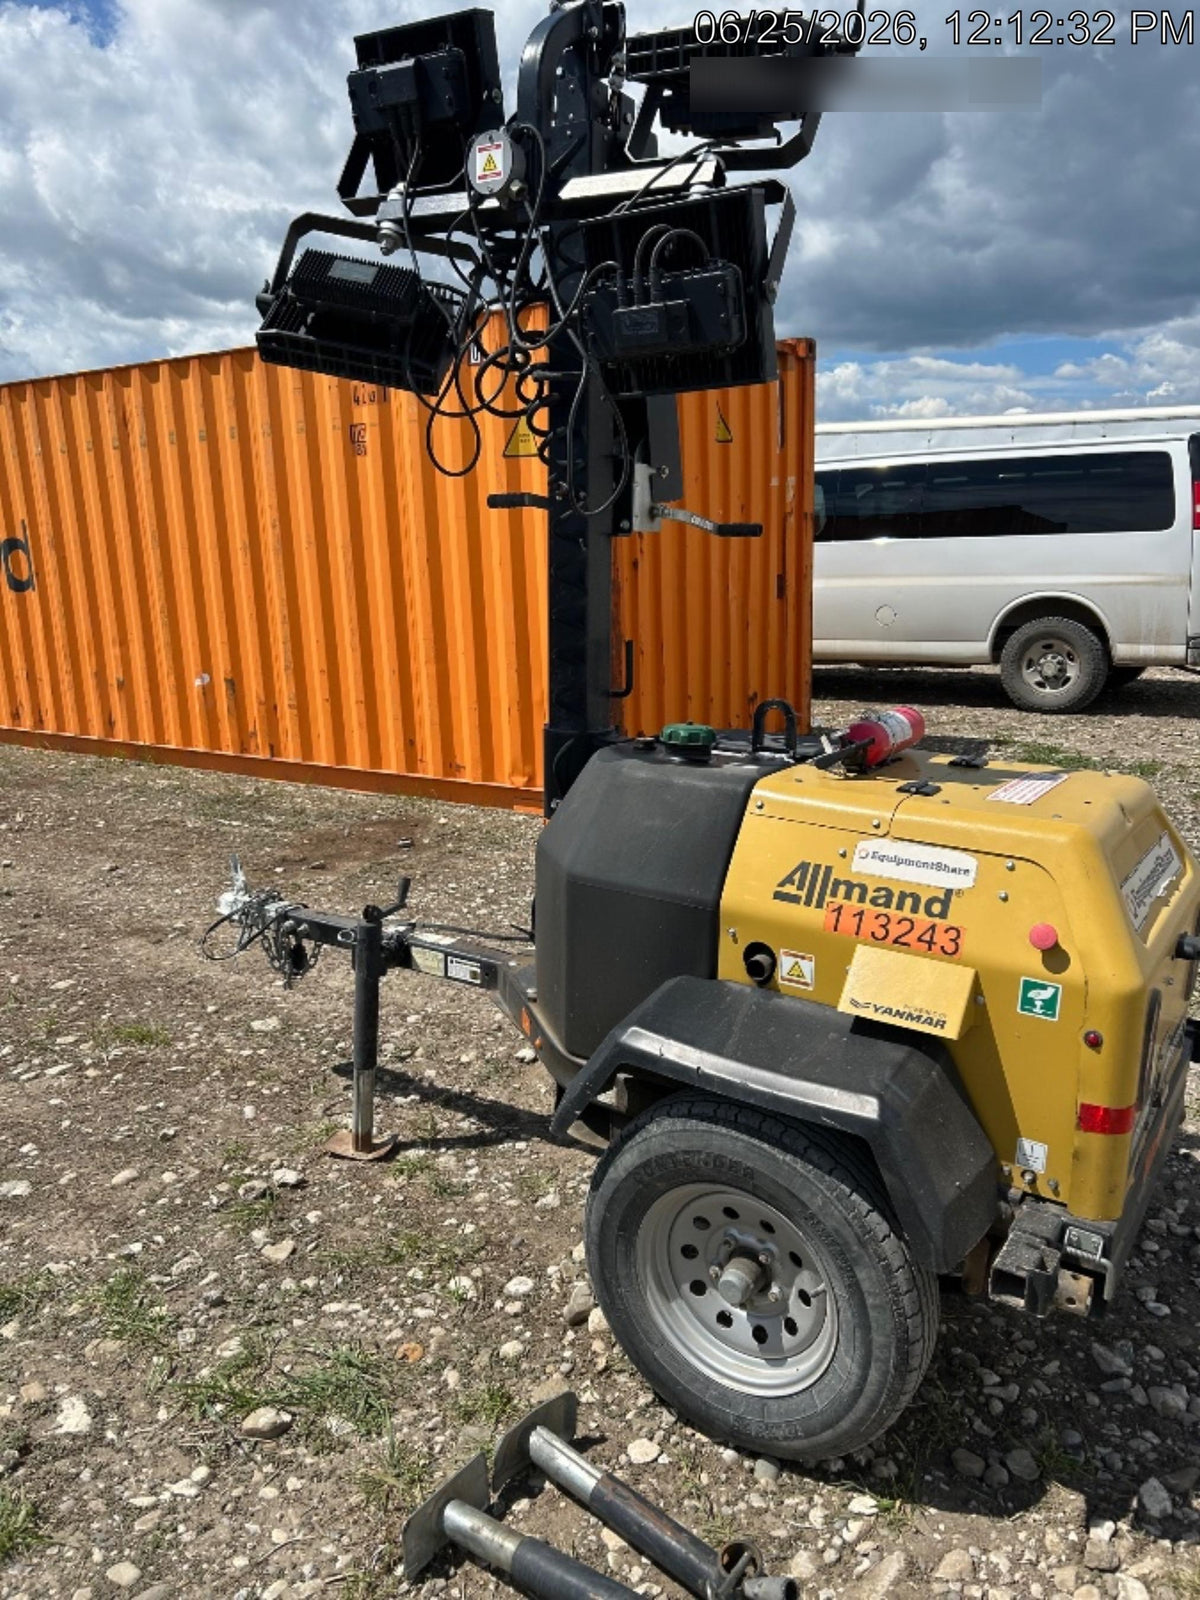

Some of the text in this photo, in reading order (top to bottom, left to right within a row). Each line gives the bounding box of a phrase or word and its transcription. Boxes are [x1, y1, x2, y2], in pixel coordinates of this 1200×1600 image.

[870, 851, 971, 876] EquipmentShare
[773, 861, 954, 919] Allmand
[830, 904, 962, 957] 113243
[872, 1003, 947, 1030] YANMAR
